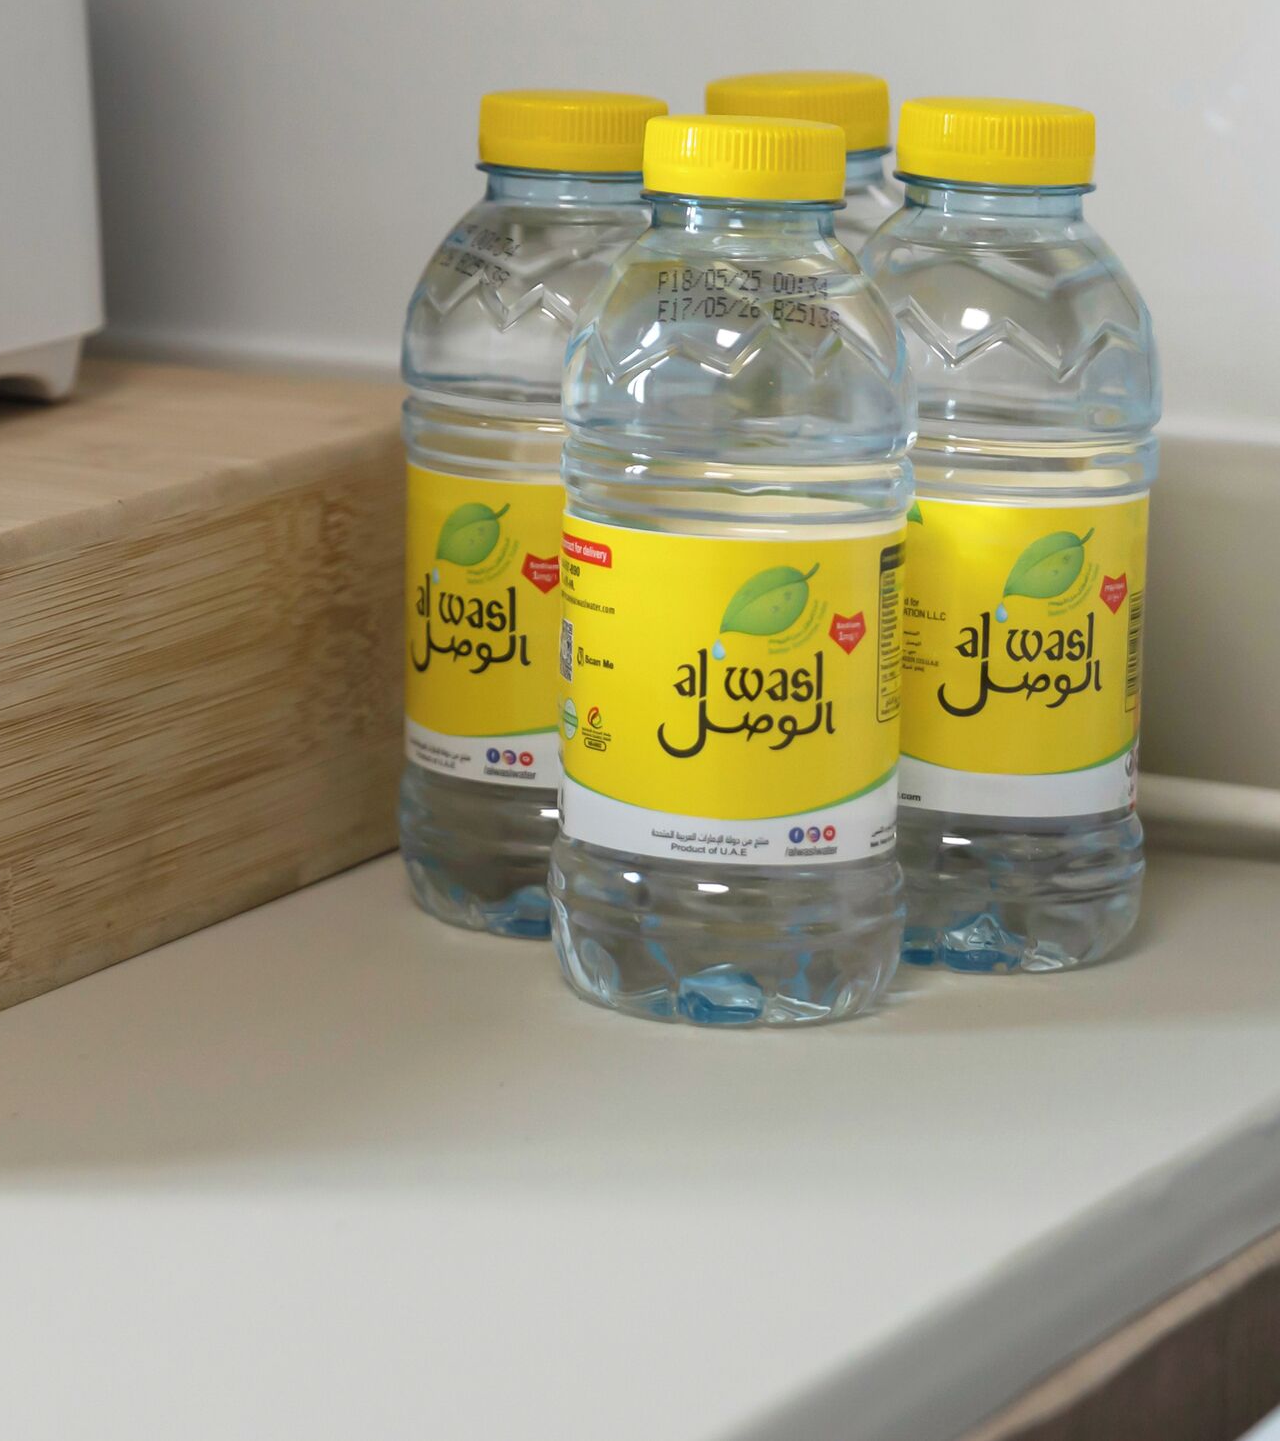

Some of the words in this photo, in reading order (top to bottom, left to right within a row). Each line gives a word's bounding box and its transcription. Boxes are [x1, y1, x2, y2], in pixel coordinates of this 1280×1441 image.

[657, 269, 762, 294] P18/05/25
[657, 297, 761, 322] E17/05/26
[583, 545, 607, 563] delivery
[416, 573, 431, 618] al
[438, 587, 516, 633] wasl
[411, 620, 532, 674] الوصل
[584, 654, 601, 667] Scan
[603, 659, 615, 670] Me
[954, 612, 991, 659] al
[1006, 612, 1095, 663] wasl
[673, 648, 708, 699] al
[724, 651, 824, 703] wasl
[937, 660, 1103, 717] الوصل
[657, 699, 836, 759] الوصل
[671, 842, 706, 854] Product
[708, 846, 718, 855] of
[720, 847, 748, 857] U.A.E
